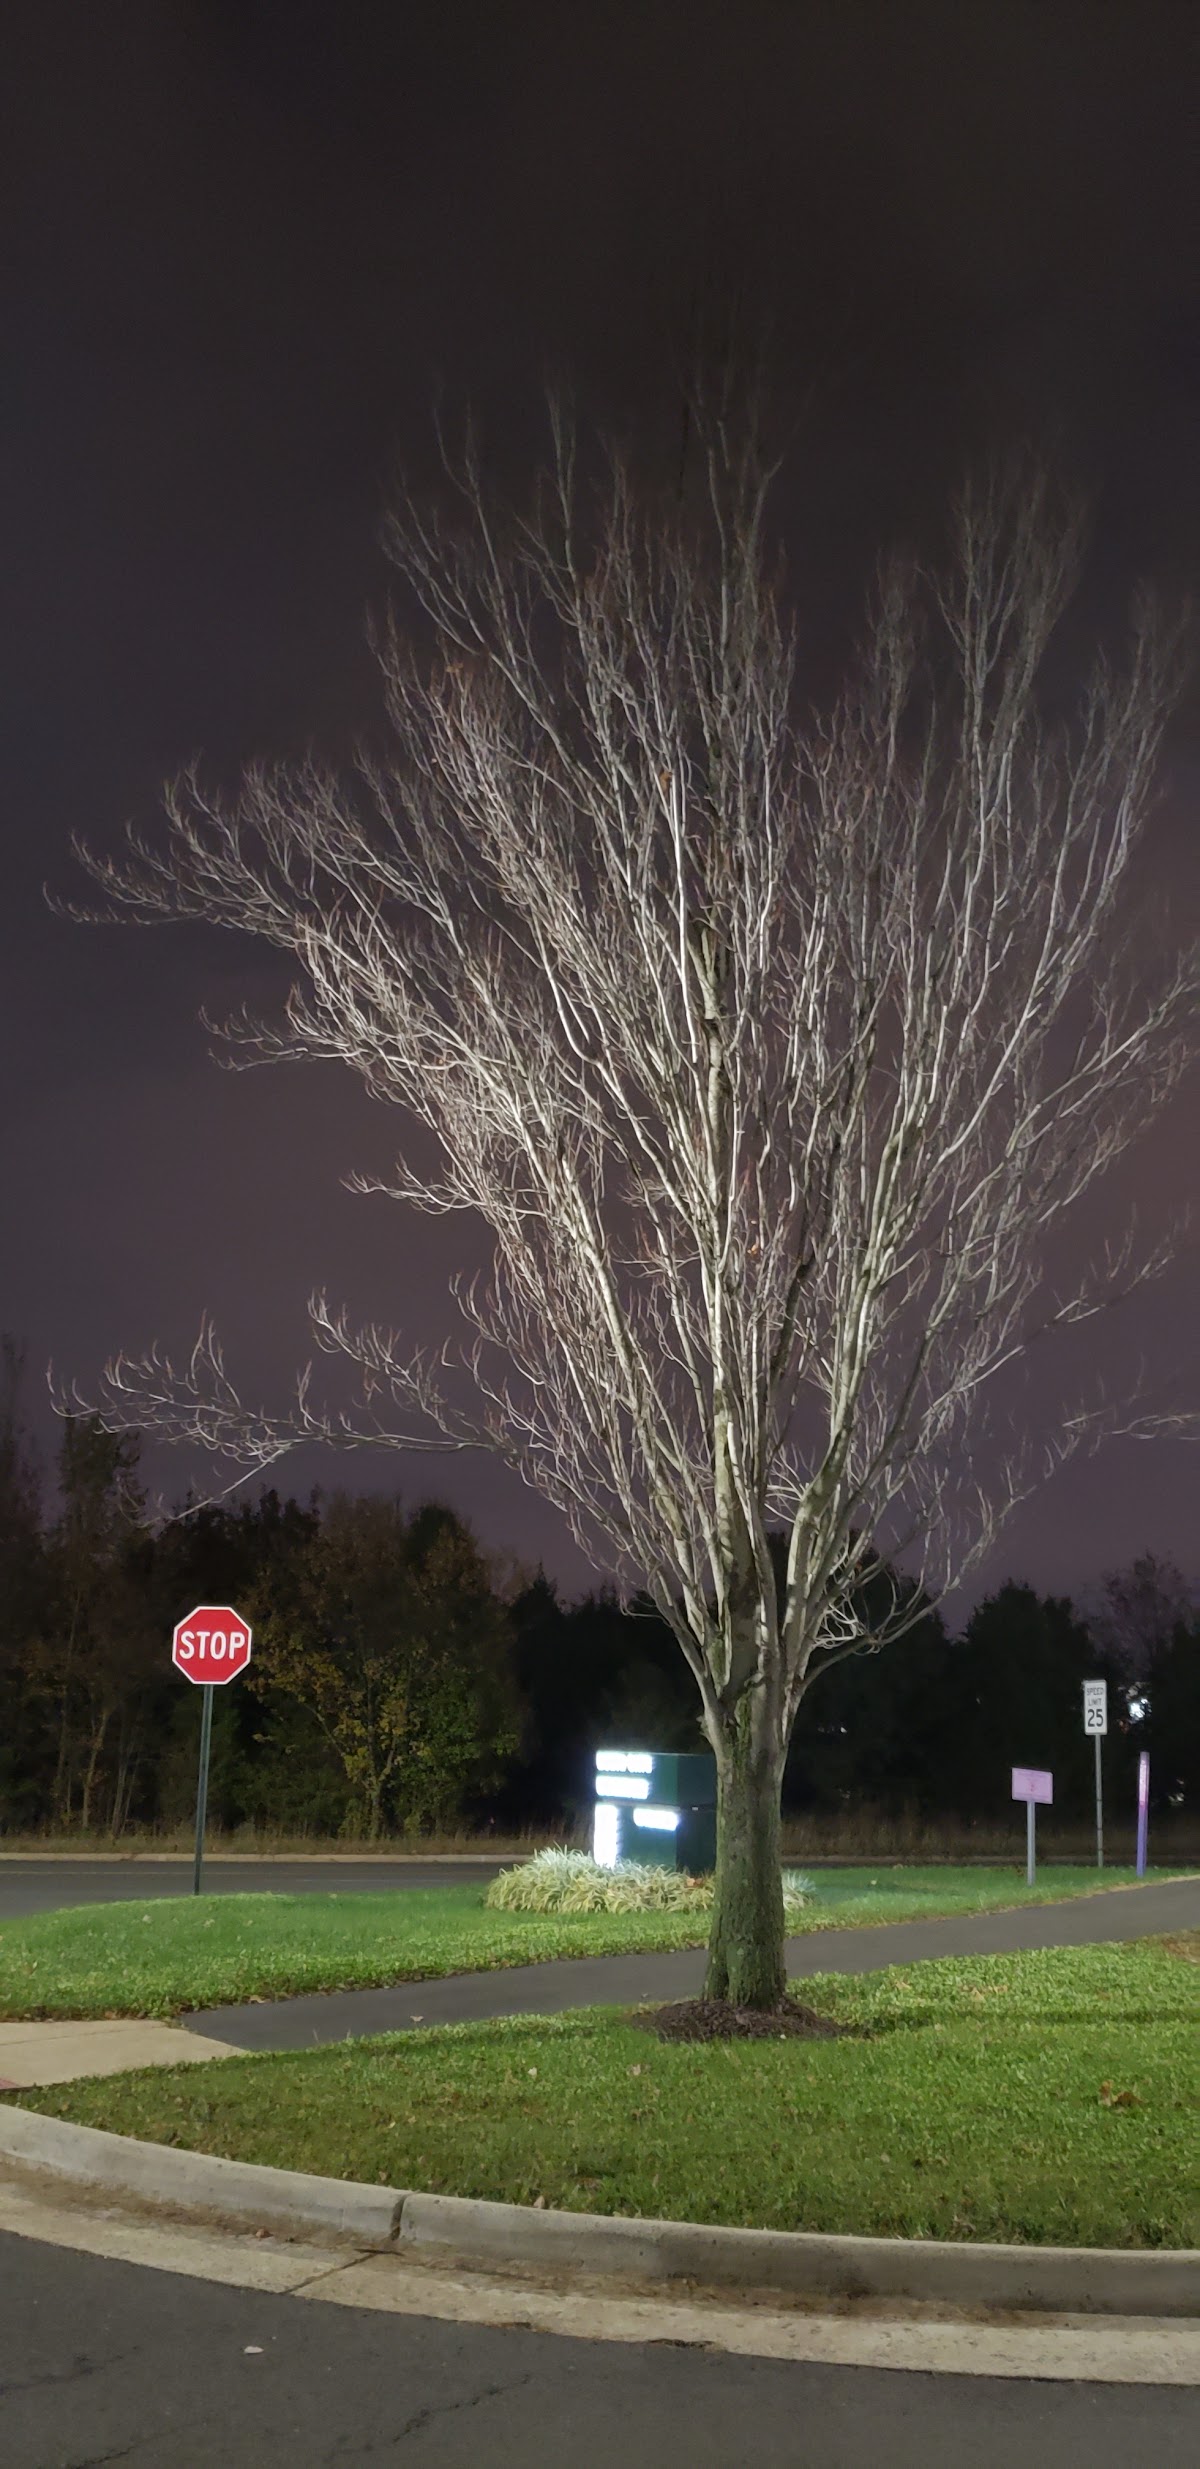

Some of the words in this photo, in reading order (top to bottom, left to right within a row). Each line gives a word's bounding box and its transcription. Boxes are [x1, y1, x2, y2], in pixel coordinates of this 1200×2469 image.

[179, 1631, 245, 1660] STOP
[1087, 1687, 1104, 1696] SPEED
[1087, 1709, 1104, 1727] 25
